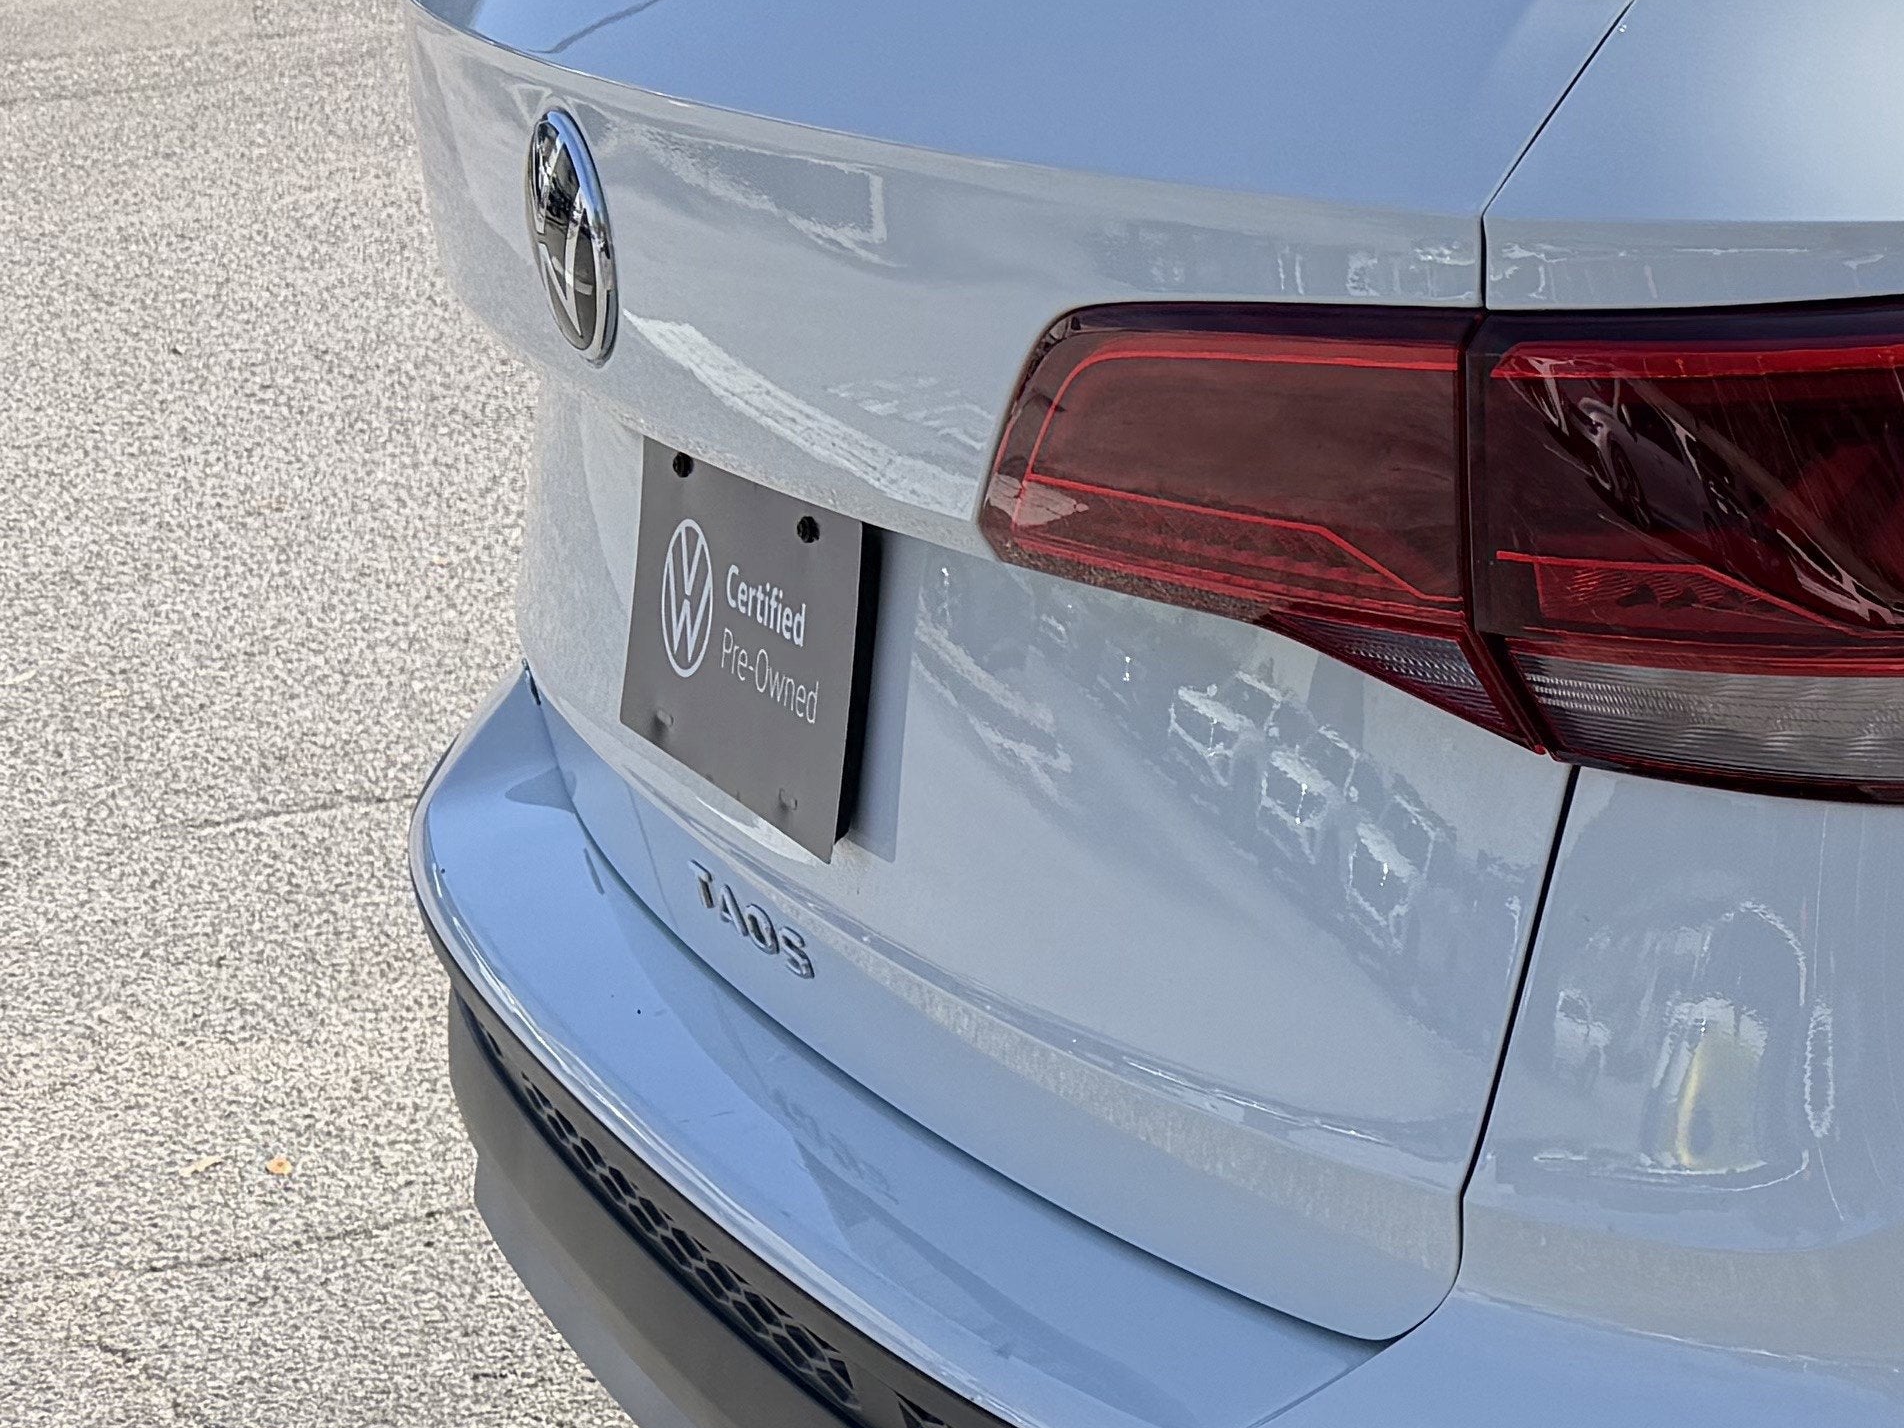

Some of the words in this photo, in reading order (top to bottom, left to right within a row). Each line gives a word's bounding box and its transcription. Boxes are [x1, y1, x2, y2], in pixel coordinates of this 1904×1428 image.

[725, 563, 808, 648] Certified
[721, 627, 820, 725] Pre-Owned
[688, 858, 816, 980] TAOS
